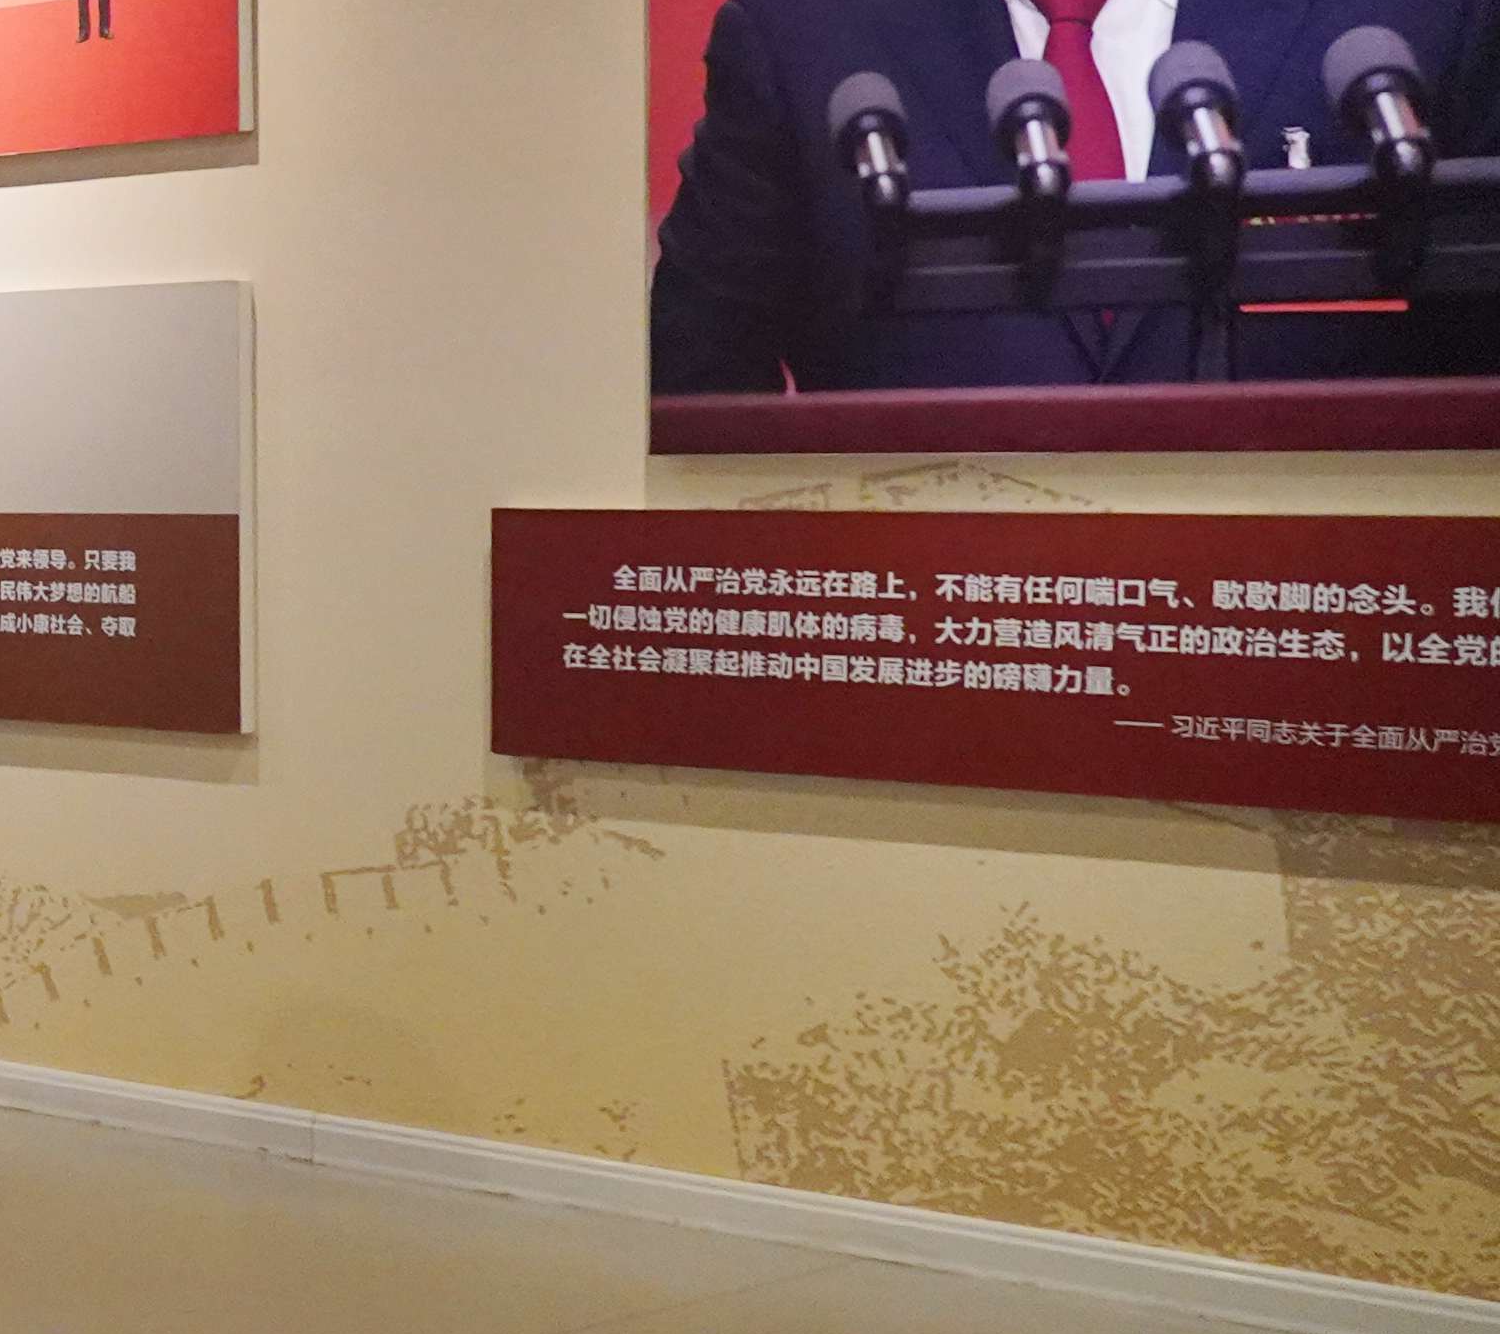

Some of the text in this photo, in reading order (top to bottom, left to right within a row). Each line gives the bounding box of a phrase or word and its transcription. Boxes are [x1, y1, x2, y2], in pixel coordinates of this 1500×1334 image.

[561, 642, 1132, 697] 在全社会凝聚起推动中国发展进步的磅礴力量。
